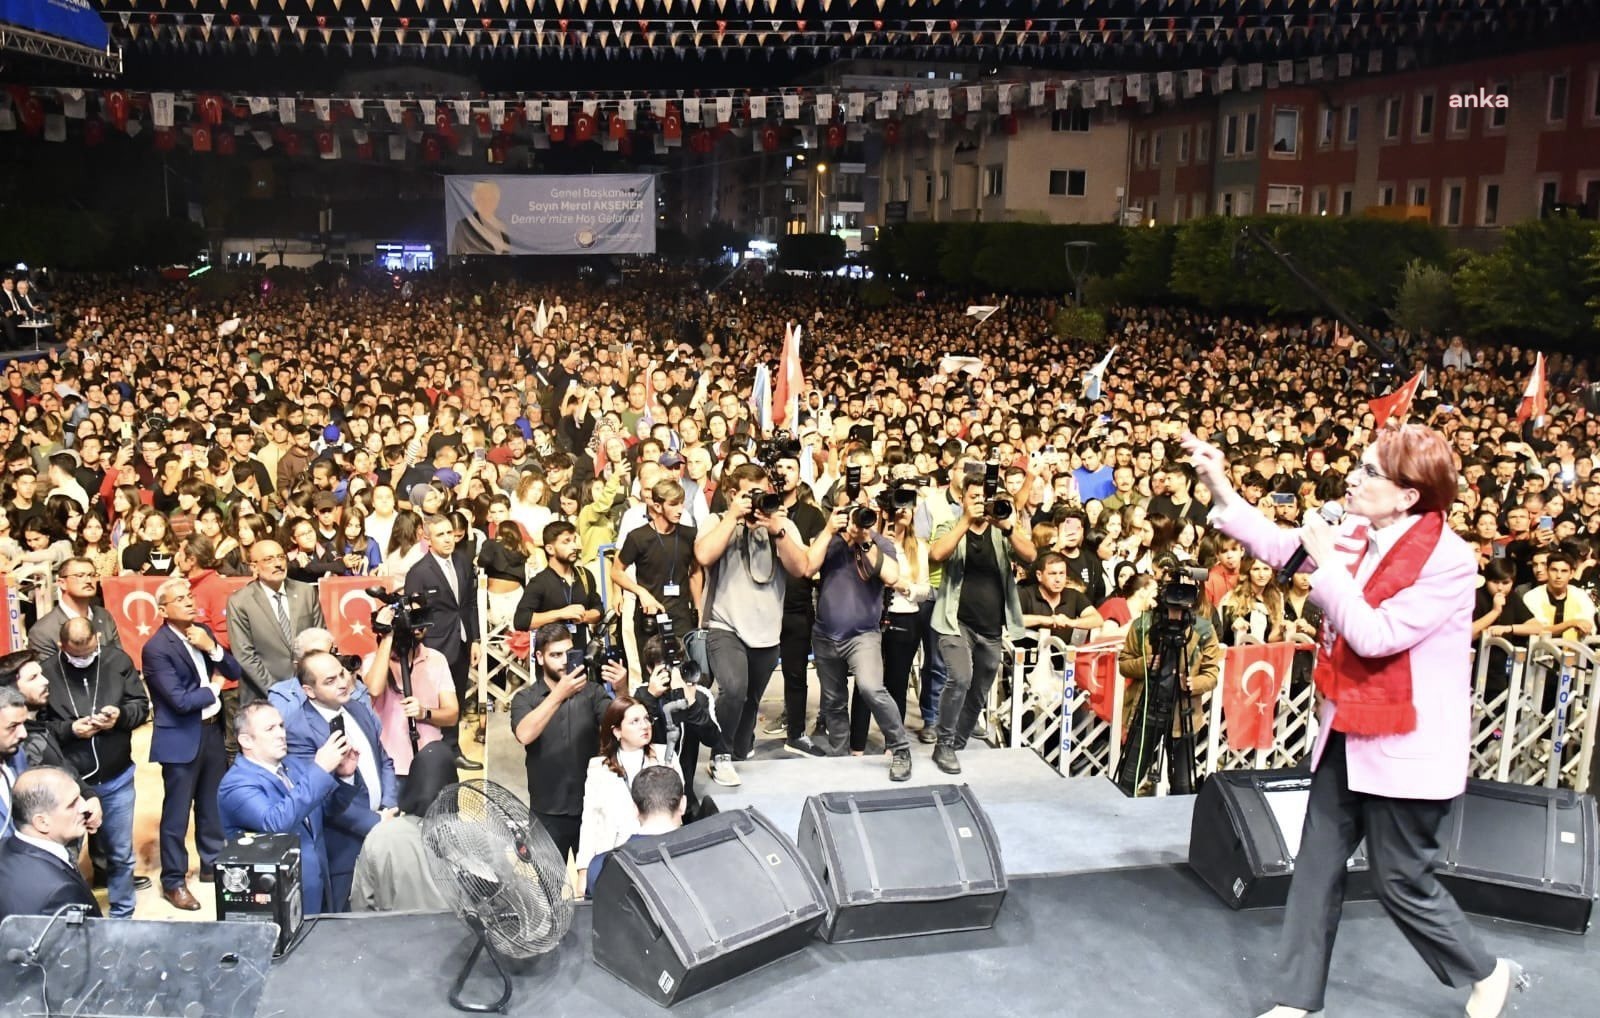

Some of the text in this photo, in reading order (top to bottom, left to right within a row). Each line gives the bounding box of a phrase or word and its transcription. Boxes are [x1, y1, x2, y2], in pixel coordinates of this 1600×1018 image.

[550, 188, 581, 198] Genel
[529, 201, 559, 212] Sayın
[560, 200, 591, 210] Meral
[511, 213, 574, 224] Demre'mize
[576, 214, 596, 226] Hoş
[1062, 669, 1074, 751] POLİS
[1554, 675, 1570, 753] POLİS
